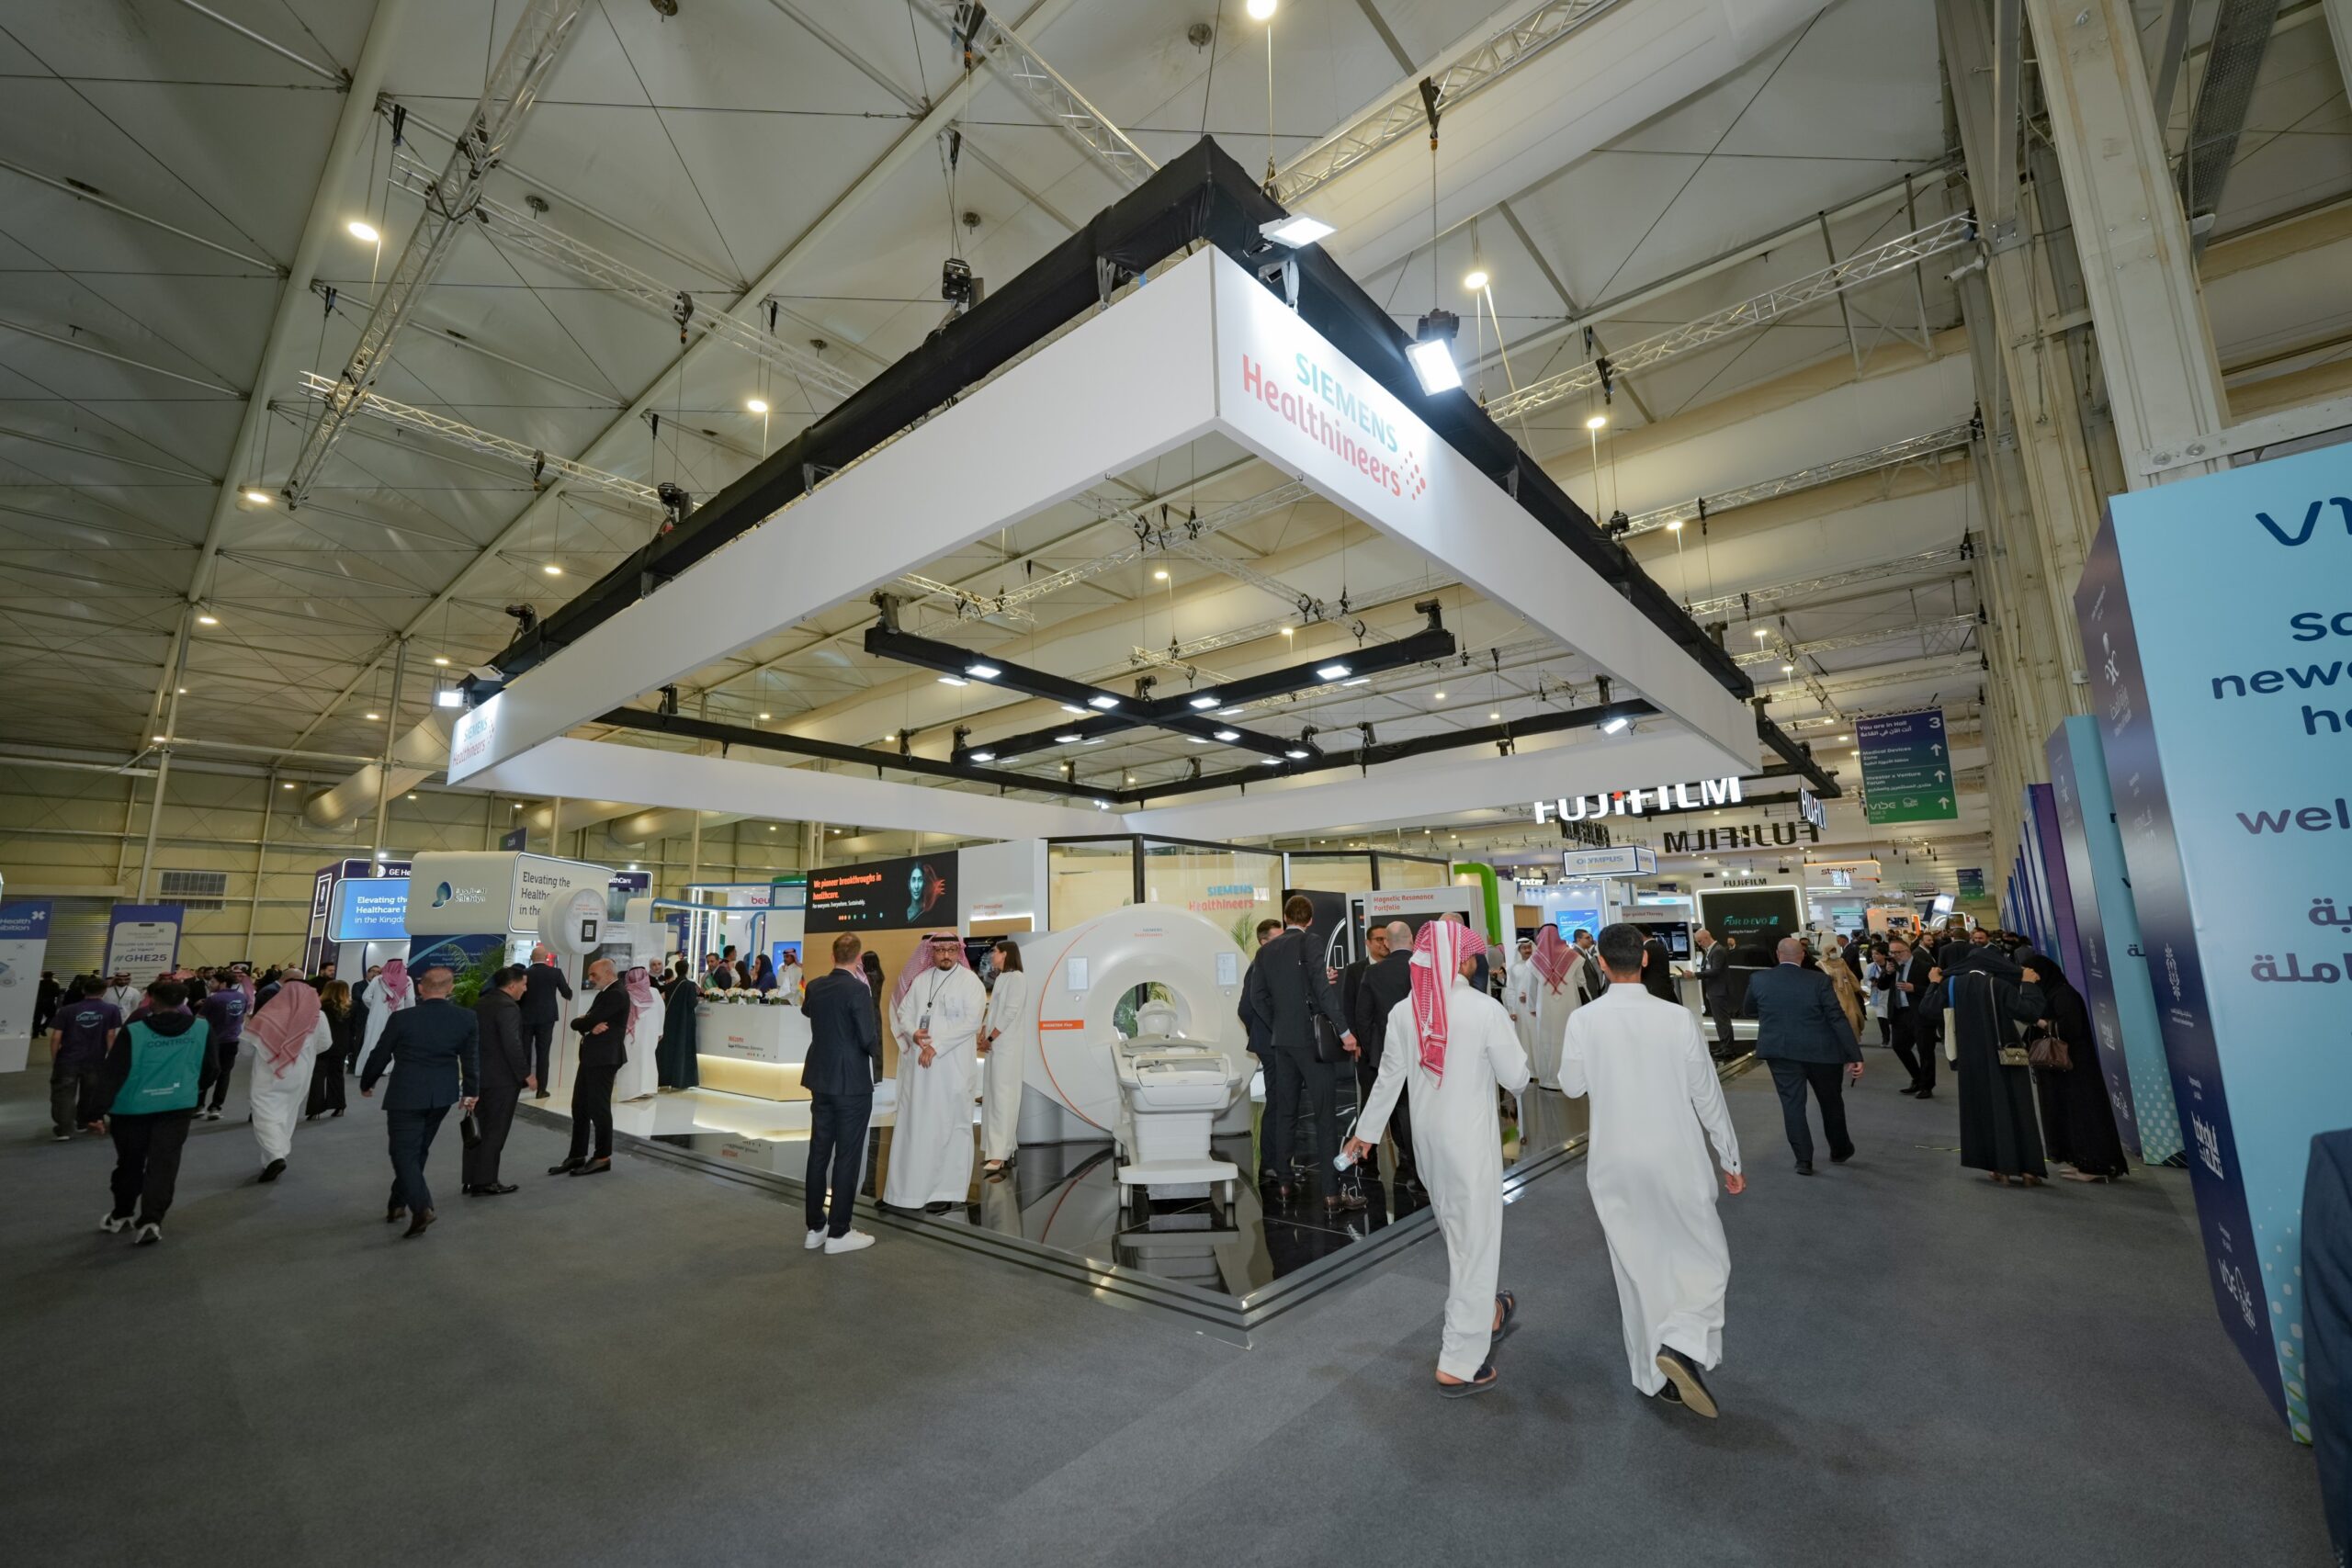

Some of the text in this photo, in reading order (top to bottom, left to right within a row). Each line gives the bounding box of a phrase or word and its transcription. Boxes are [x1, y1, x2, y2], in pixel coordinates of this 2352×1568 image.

[1295, 353, 1398, 453] SIEMENS
[1243, 353, 1401, 497] Healthineers
[2211, 660, 2352, 699] new
[1929, 717, 1941, 728] 3
[1534, 776, 1742, 824] FUJIFILM
[1577, 855, 1623, 864] OLYMPUS
[523, 872, 571, 888] Elevating the
[1724, 878, 1767, 887] FUJIFILM
[1207, 884, 1254, 897] SIEMENS
[357, 897, 395, 905] Elevating
[1189, 899, 1255, 912] Healthineers
[1374, 895, 1400, 905] Magnetic
[356, 906, 401, 914] Healthcare
[520, 904, 527, 914] in
[1374, 904, 1401, 912] Portfolio
